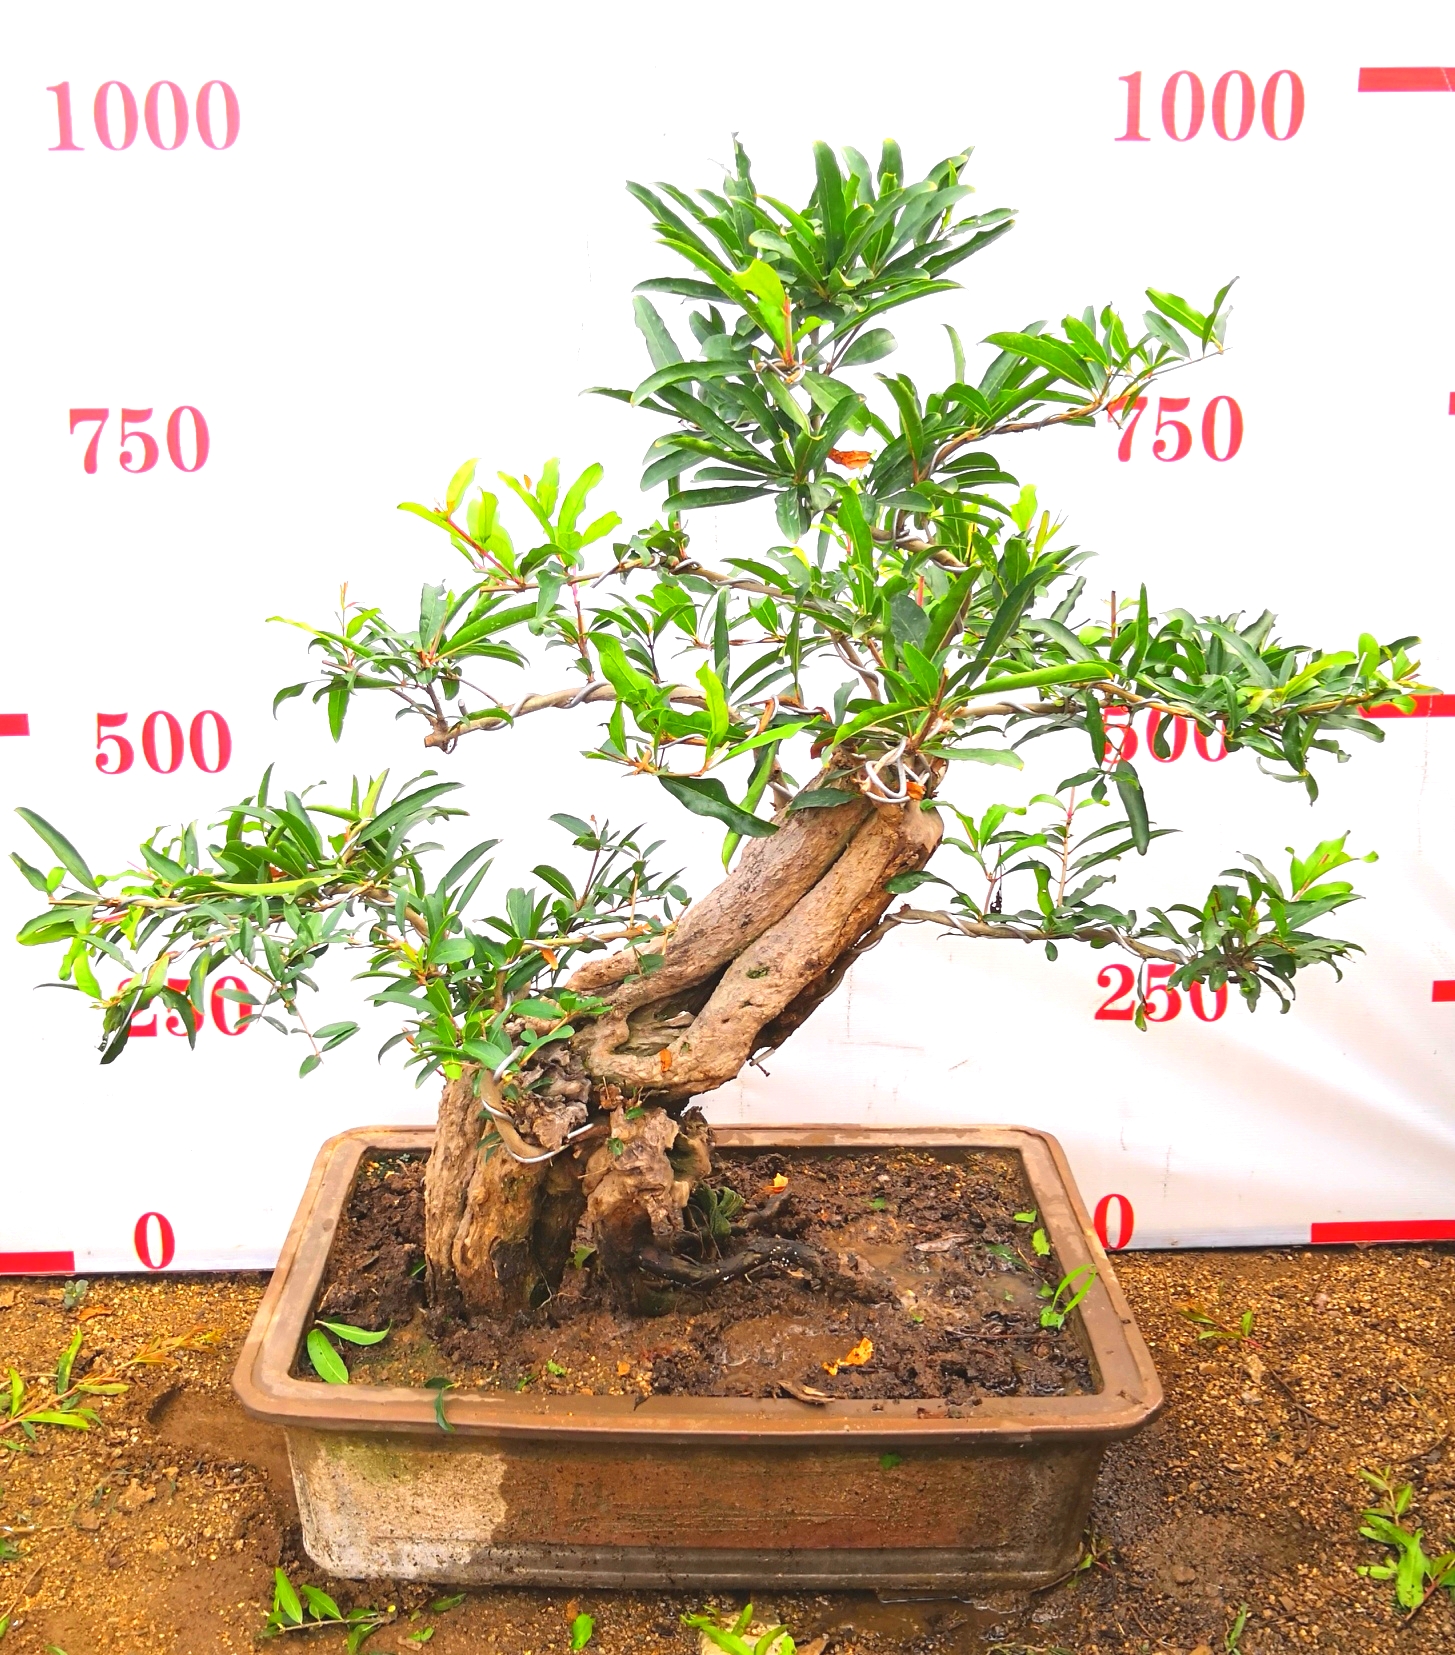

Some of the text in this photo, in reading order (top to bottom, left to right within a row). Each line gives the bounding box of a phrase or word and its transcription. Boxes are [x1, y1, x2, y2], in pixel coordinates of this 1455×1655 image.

[46, 80, 241, 151] 1000
[1115, 70, 1306, 142] 1000
[69, 405, 211, 474] 750
[1107, 395, 1244, 462] 750
[96, 710, 232, 774] 500
[1094, 963, 1229, 1022] 250
[134, 1212, 175, 1272] 0
[1093, 1193, 1135, 1250] 0
